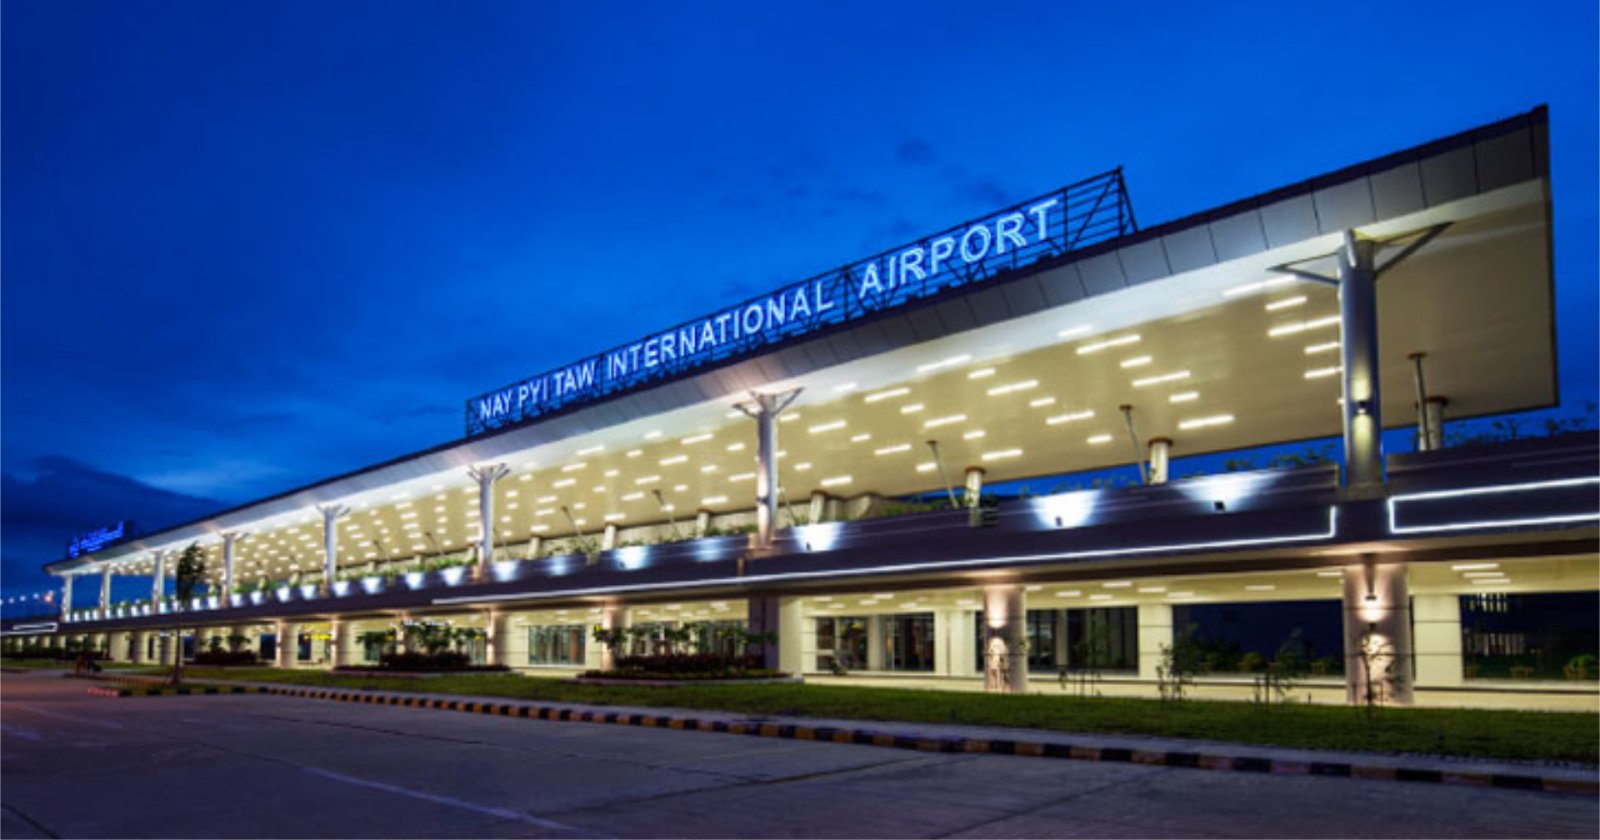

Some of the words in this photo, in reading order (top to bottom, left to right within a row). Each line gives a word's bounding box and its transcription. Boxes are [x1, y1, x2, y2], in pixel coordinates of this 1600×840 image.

[479, 392, 512, 420] NAY
[518, 378, 548, 408] PYI
[554, 361, 596, 395] TAW
[607, 282, 835, 380] INTERNATIONAL
[859, 198, 1059, 299] AIRPORT
